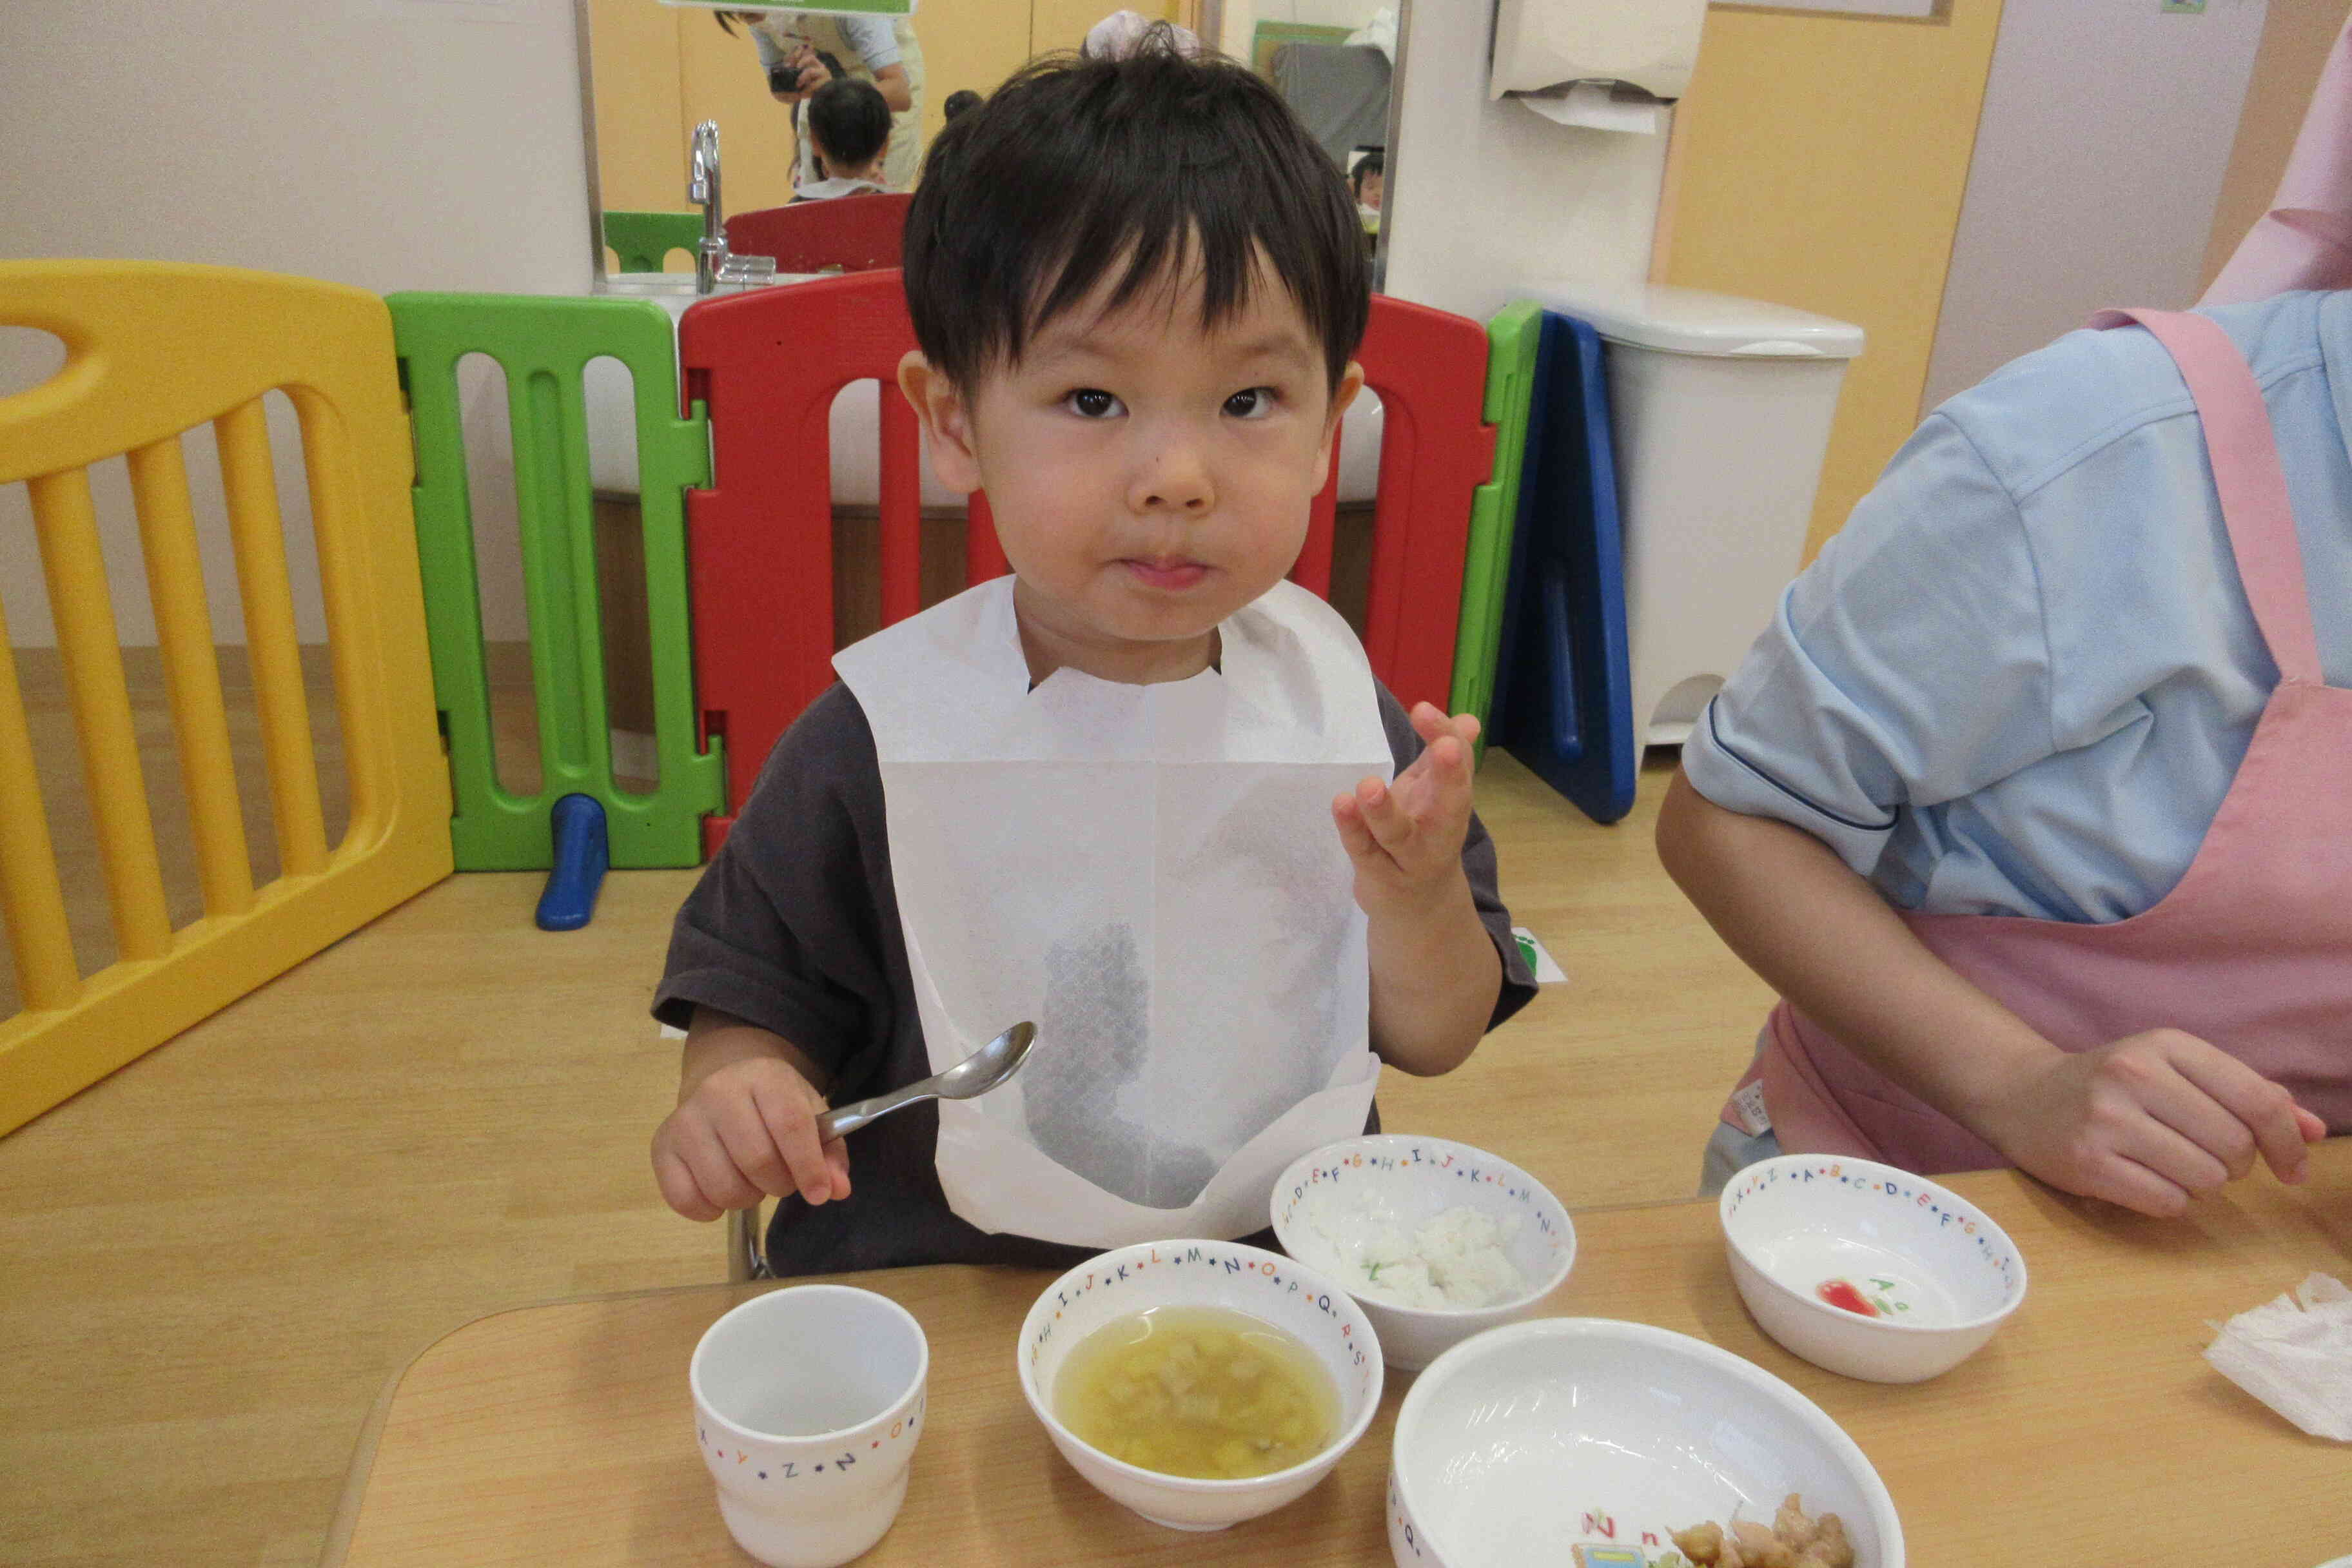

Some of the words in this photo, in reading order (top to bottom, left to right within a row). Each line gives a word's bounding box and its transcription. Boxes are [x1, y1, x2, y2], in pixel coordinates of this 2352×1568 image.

[1295, 1187, 1302, 1199] D
[1313, 1168, 1320, 1183] E
[1331, 1167, 1339, 1182] F
[1381, 1157, 1393, 1171] H
[1412, 1149, 1422, 1162] I
[1441, 1155, 1453, 1168] J
[1471, 1169, 1480, 1182] K
[1541, 1219, 1550, 1233] N
[1805, 1169, 1814, 1182] A
[1830, 1164, 1840, 1177] B
[1854, 1178, 1866, 1189] C
[1885, 1182, 1897, 1195] D
[1917, 1193, 1931, 1207] E
[1941, 1213, 1950, 1226] F
[1965, 1222, 1976, 1234] G
[1043, 1323, 1052, 1341] H
[1058, 1291, 1068, 1307] I
[1086, 1274, 1094, 1290] J
[1117, 1265, 1130, 1281] K
[1152, 1249, 1162, 1264] L
[1188, 1247, 1201, 1262] M
[1224, 1258, 1240, 1274] N
[1261, 1262, 1276, 1276] O
[1288, 1281, 1298, 1293] P
[1318, 1295, 1329, 1314] Q
[1341, 1324, 1351, 1338] R
[1354, 1351, 1361, 1366] S
[737, 1450, 747, 1465] Y
[782, 1462, 799, 1478] Z
[890, 1421, 902, 1439] O
[1405, 1524, 1413, 1549] Q
